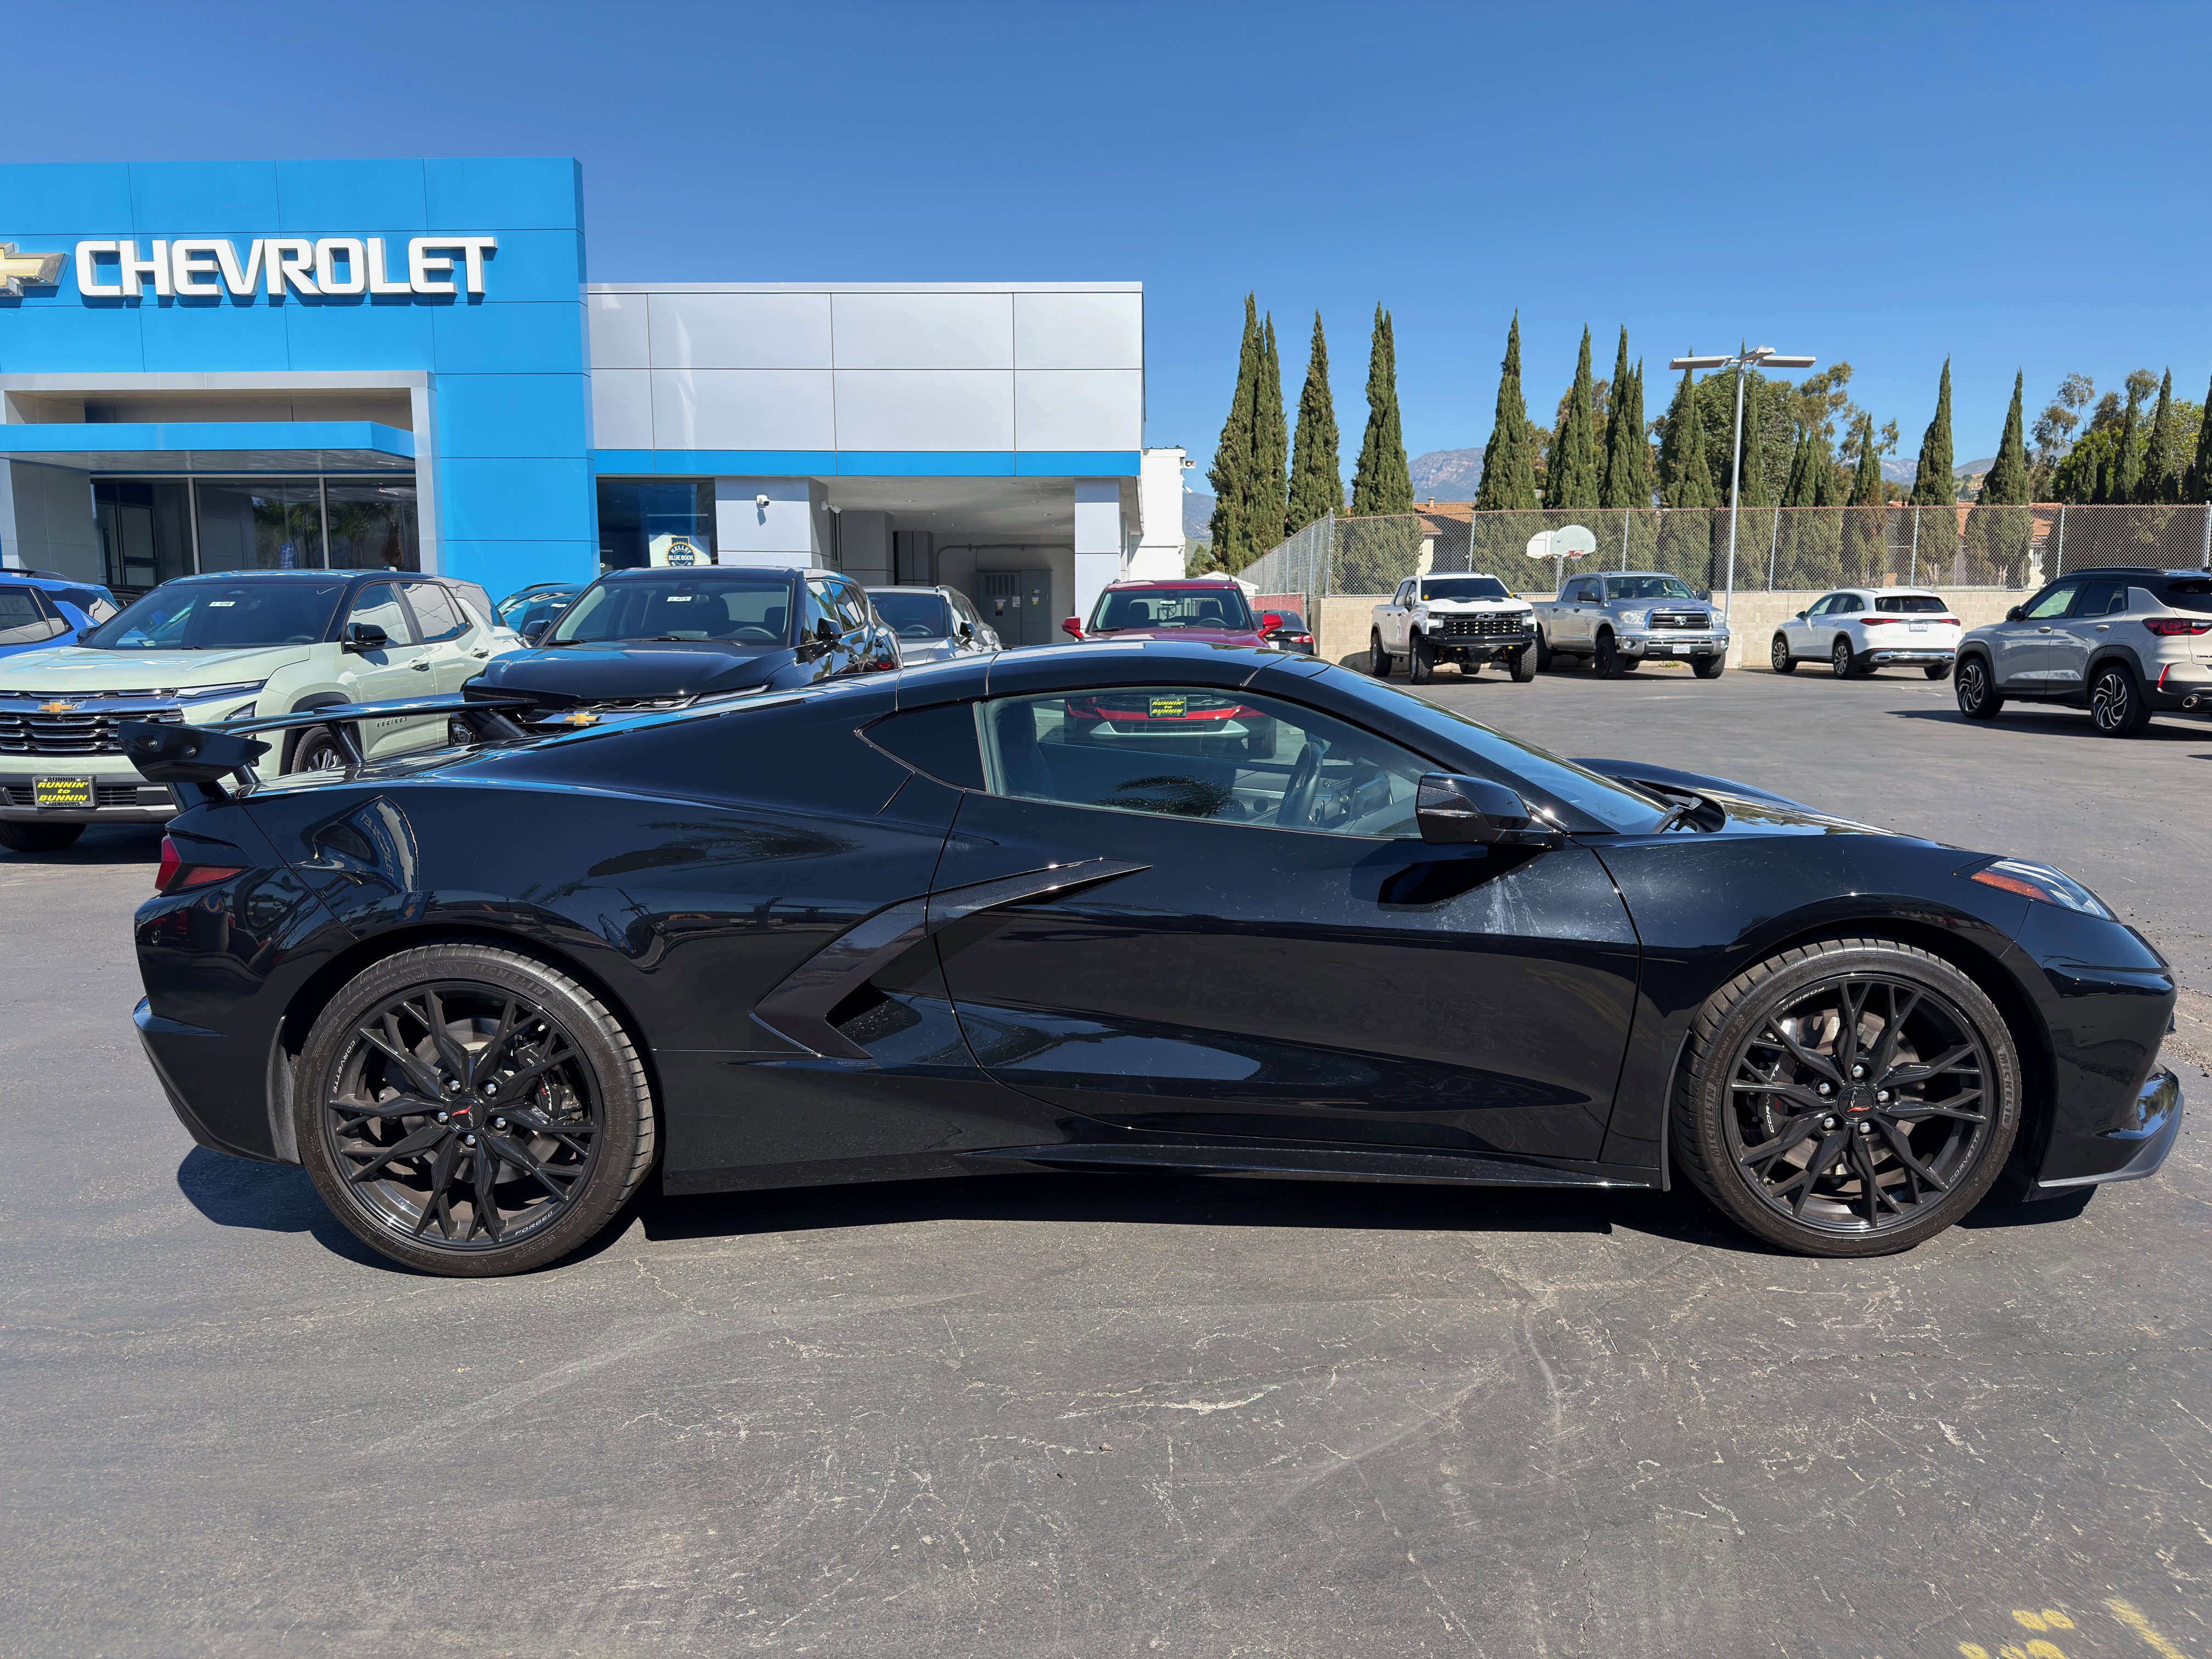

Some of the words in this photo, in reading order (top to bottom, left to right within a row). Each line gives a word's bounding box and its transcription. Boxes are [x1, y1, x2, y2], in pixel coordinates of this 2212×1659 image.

[75, 236, 496, 297] CHEVROLET
[670, 545, 692, 554] KELLEY
[1782, 986, 1825, 1011] FORGED
[333, 1040, 356, 1094] CORVETTE
[1999, 1053, 2013, 1125] MICHELIN
[1706, 1086, 1721, 1158] MICHELIN
[1949, 1130, 1981, 1183] CORVETTE
[515, 1210, 553, 1235] FORGED
